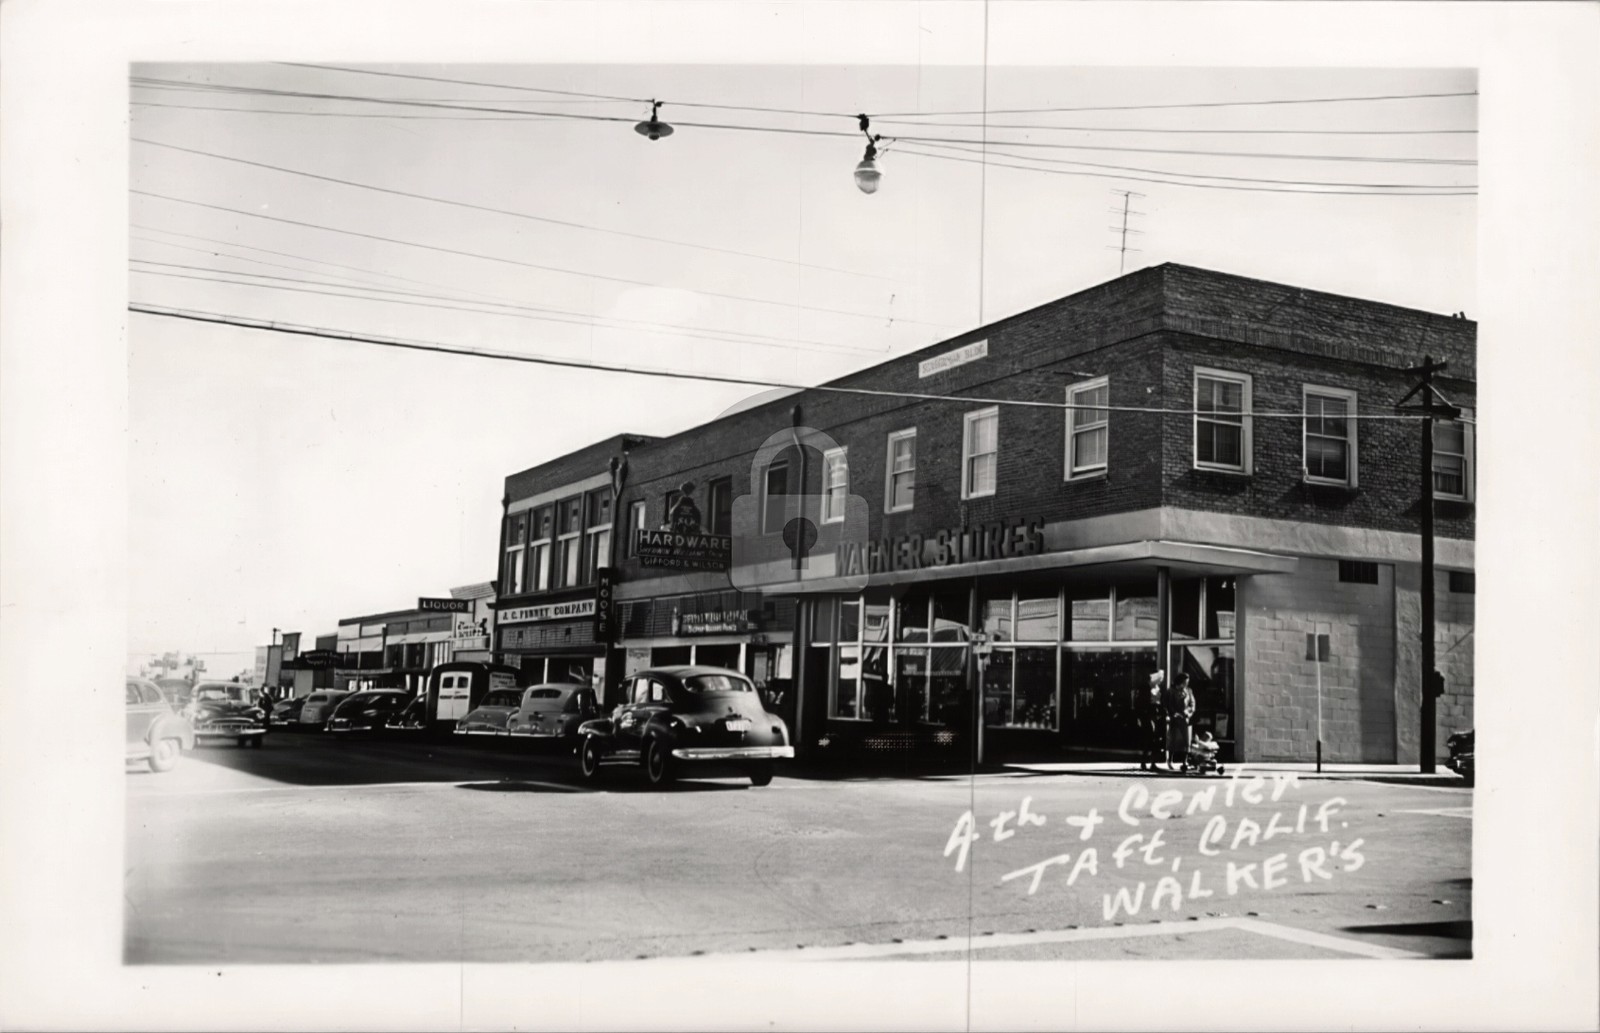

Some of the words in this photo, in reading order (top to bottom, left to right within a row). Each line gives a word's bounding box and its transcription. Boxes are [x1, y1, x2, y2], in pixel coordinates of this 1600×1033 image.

[639, 530, 730, 550] HARDWARE
[835, 534, 924, 577] WAGNER
[934, 515, 1046, 566] STORES
[644, 557, 681, 568] GIFFORD
[692, 561, 724, 570] WILSON
[422, 600, 465, 610] LIQUOR
[554, 601, 594, 616] COMPANY
[599, 577, 609, 632] MOOSE
